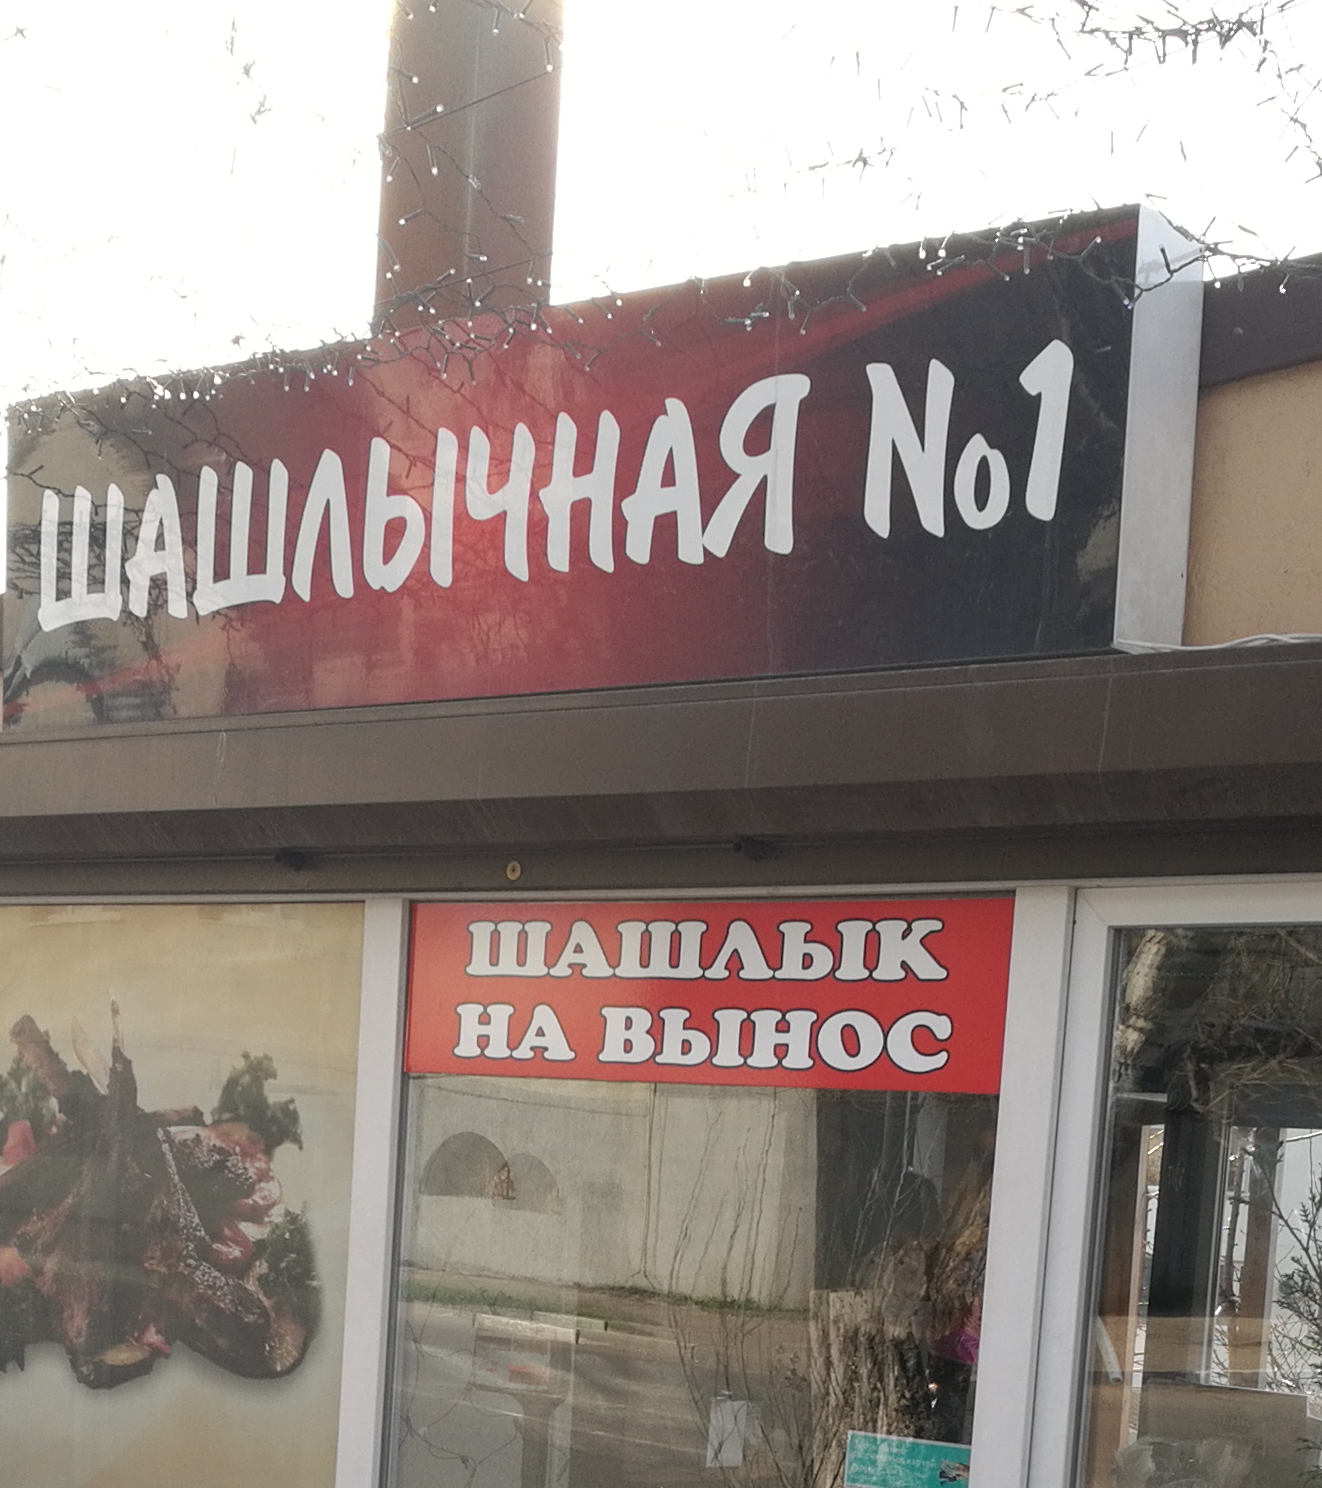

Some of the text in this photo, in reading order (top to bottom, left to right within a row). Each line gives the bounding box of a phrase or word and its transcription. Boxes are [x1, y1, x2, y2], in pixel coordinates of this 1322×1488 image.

[38, 371, 810, 632] ШАШЛЫЧНАЯ
[465, 917, 950, 982] ШАШЛЫК
[452, 1002, 954, 1073] НА ВЫНОС
